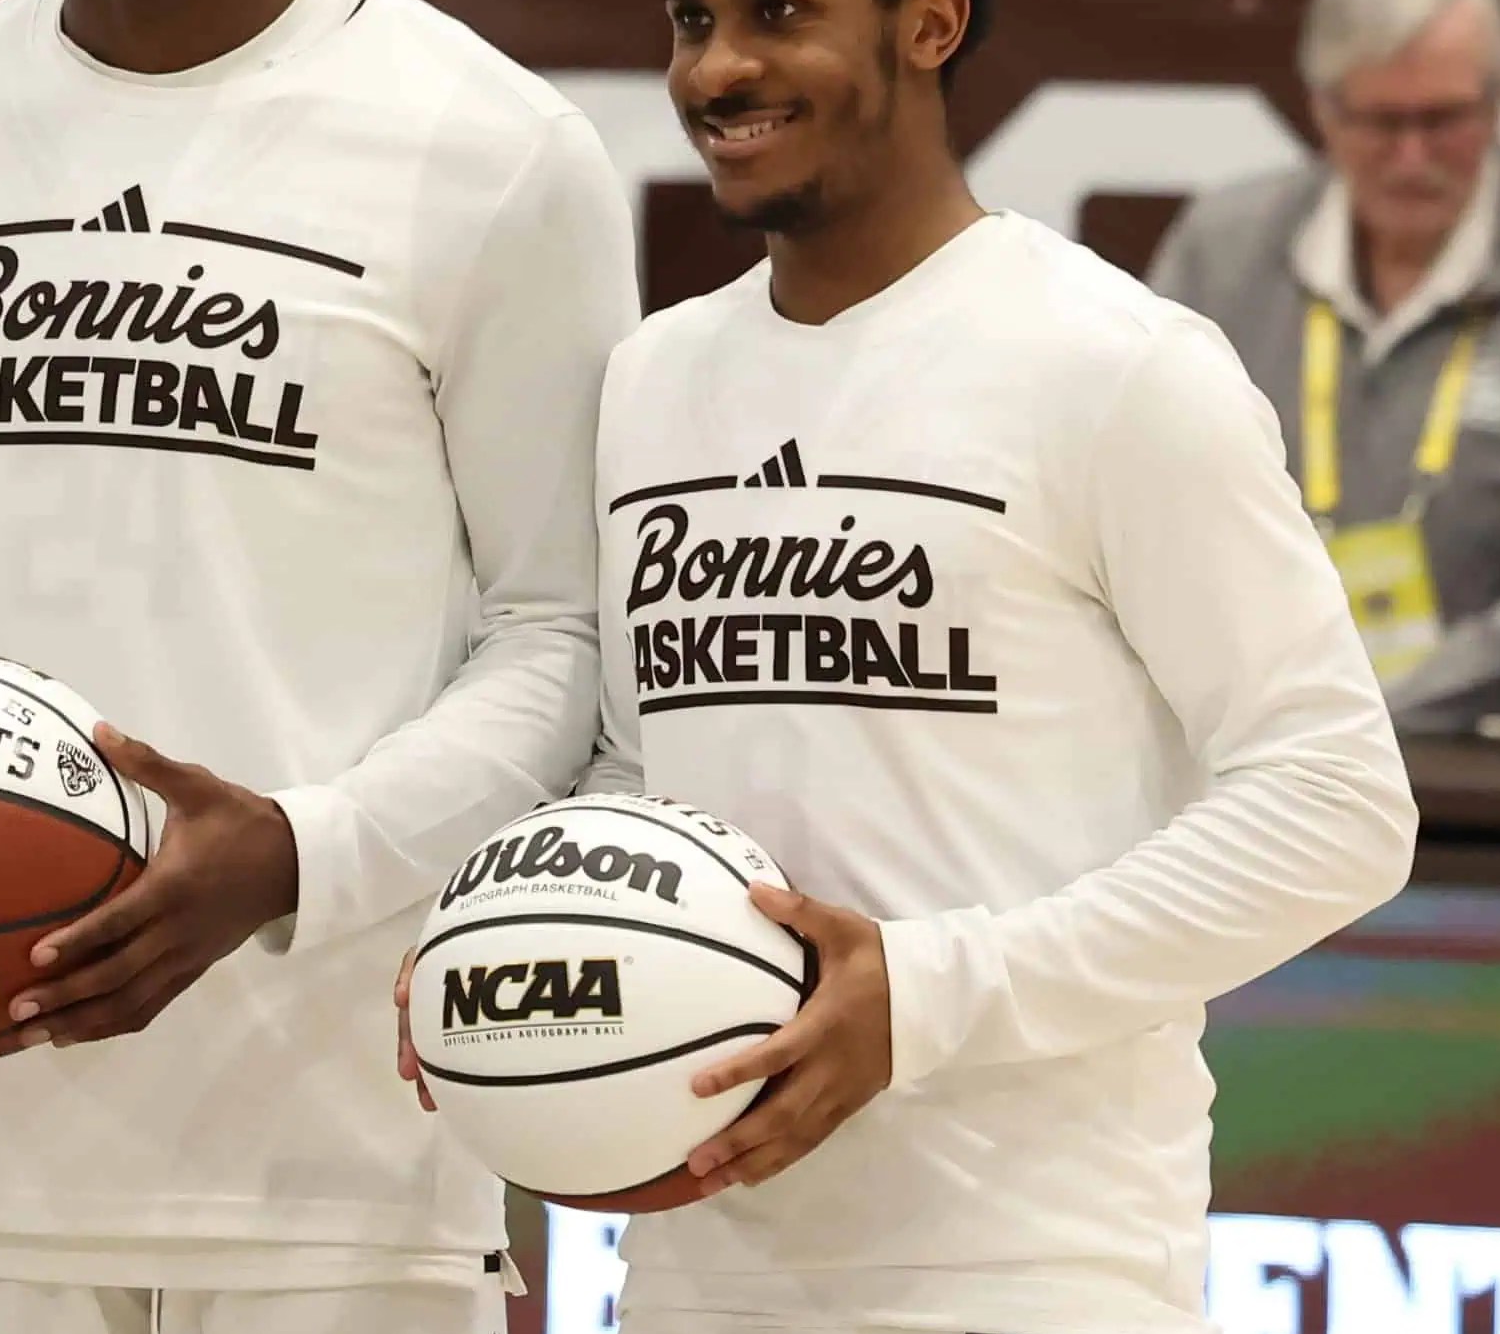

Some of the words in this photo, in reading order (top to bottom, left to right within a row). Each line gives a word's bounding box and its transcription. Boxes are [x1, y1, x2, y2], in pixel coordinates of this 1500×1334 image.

[626, 504, 933, 618] Bonnies
[633, 613, 997, 692] ASKETBALL
[439, 826, 683, 911] Wilson
[458, 884, 529, 910] AUTOGRAPH
[531, 883, 619, 902] BASKETBALL
[442, 956, 623, 1029] NCAA
